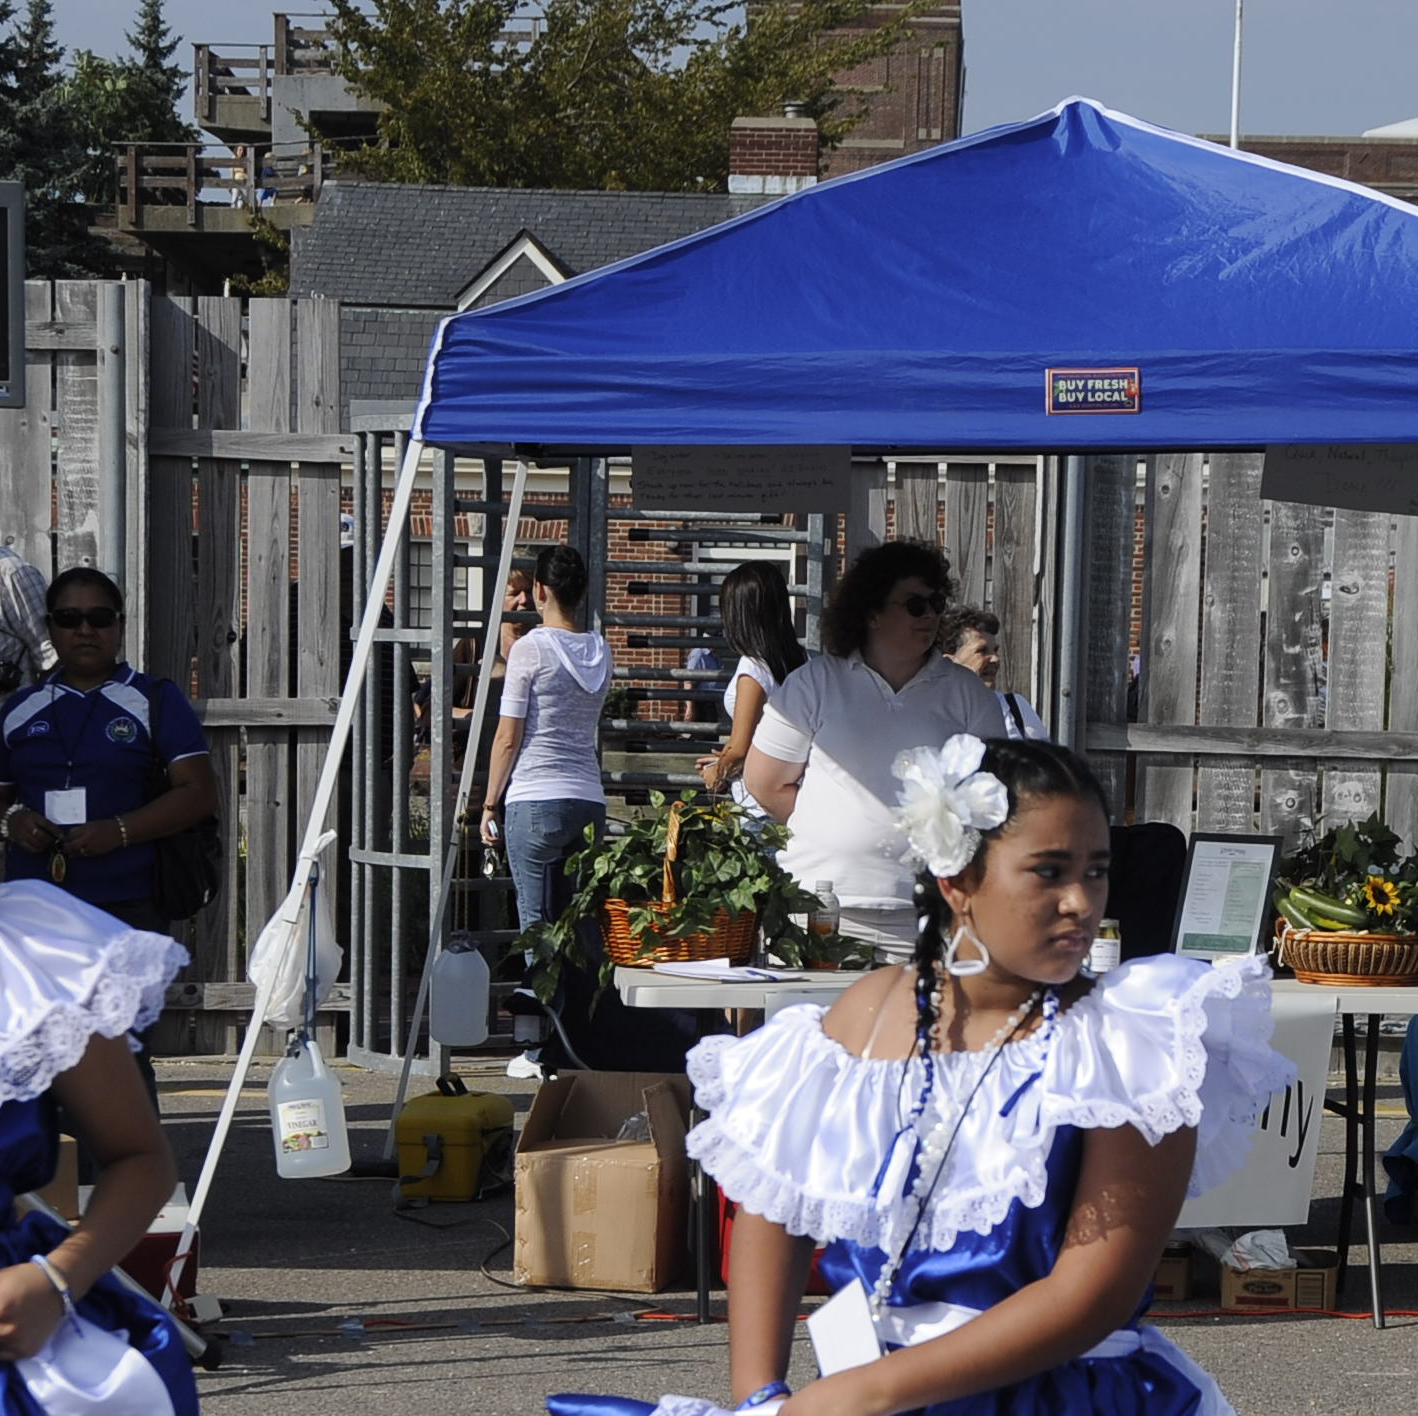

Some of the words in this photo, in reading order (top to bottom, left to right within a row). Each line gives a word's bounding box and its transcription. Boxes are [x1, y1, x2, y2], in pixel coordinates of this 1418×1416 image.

[1058, 380, 1085, 391] BUY
[1087, 379, 1128, 390] FRESH
[1058, 392, 1085, 403] BUY
[1087, 391, 1128, 402] LOCAL
